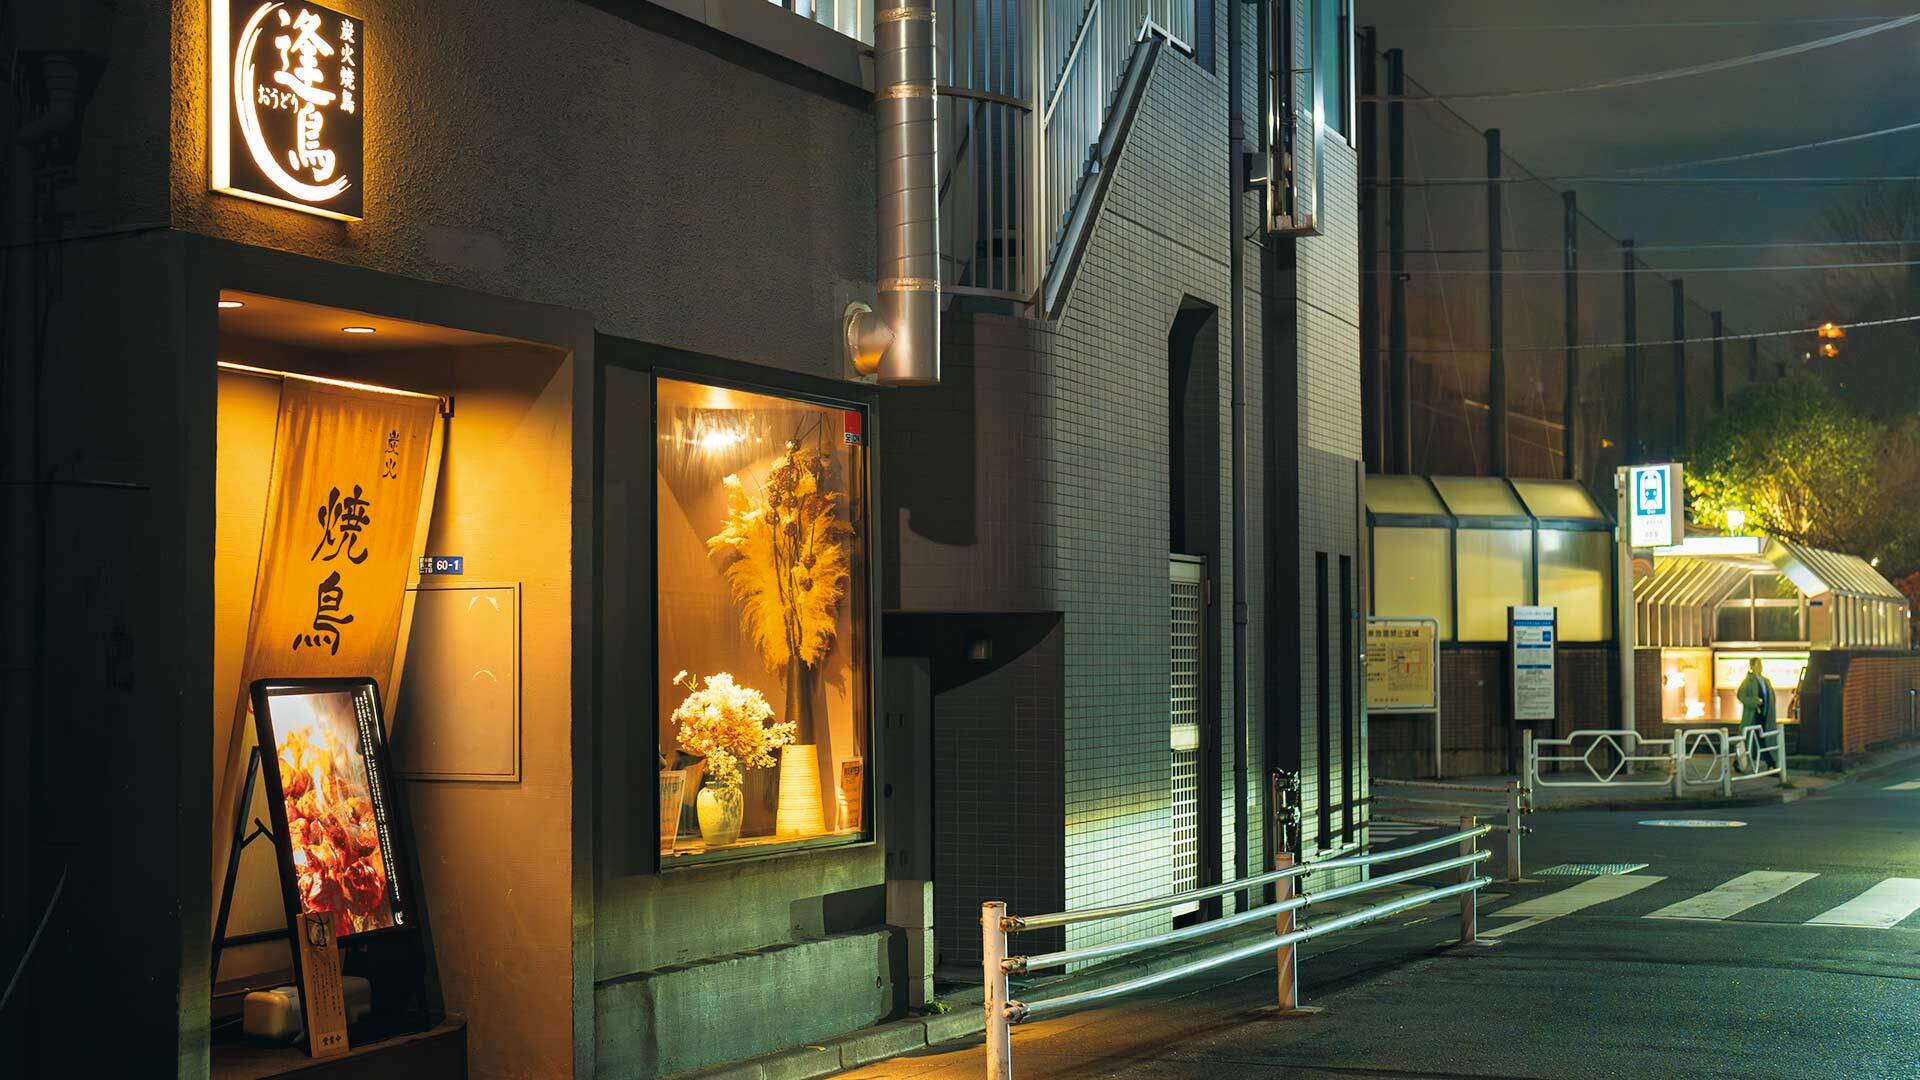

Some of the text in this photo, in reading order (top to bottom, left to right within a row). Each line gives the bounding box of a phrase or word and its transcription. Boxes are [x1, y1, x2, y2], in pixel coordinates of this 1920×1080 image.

[339, 18, 356, 115] 炭火焼鳥
[257, 83, 299, 114] おうどり
[382, 429, 400, 480] 炭火
[292, 484, 371, 656] 焼鳥
[436, 559, 459, 571] 60-1
